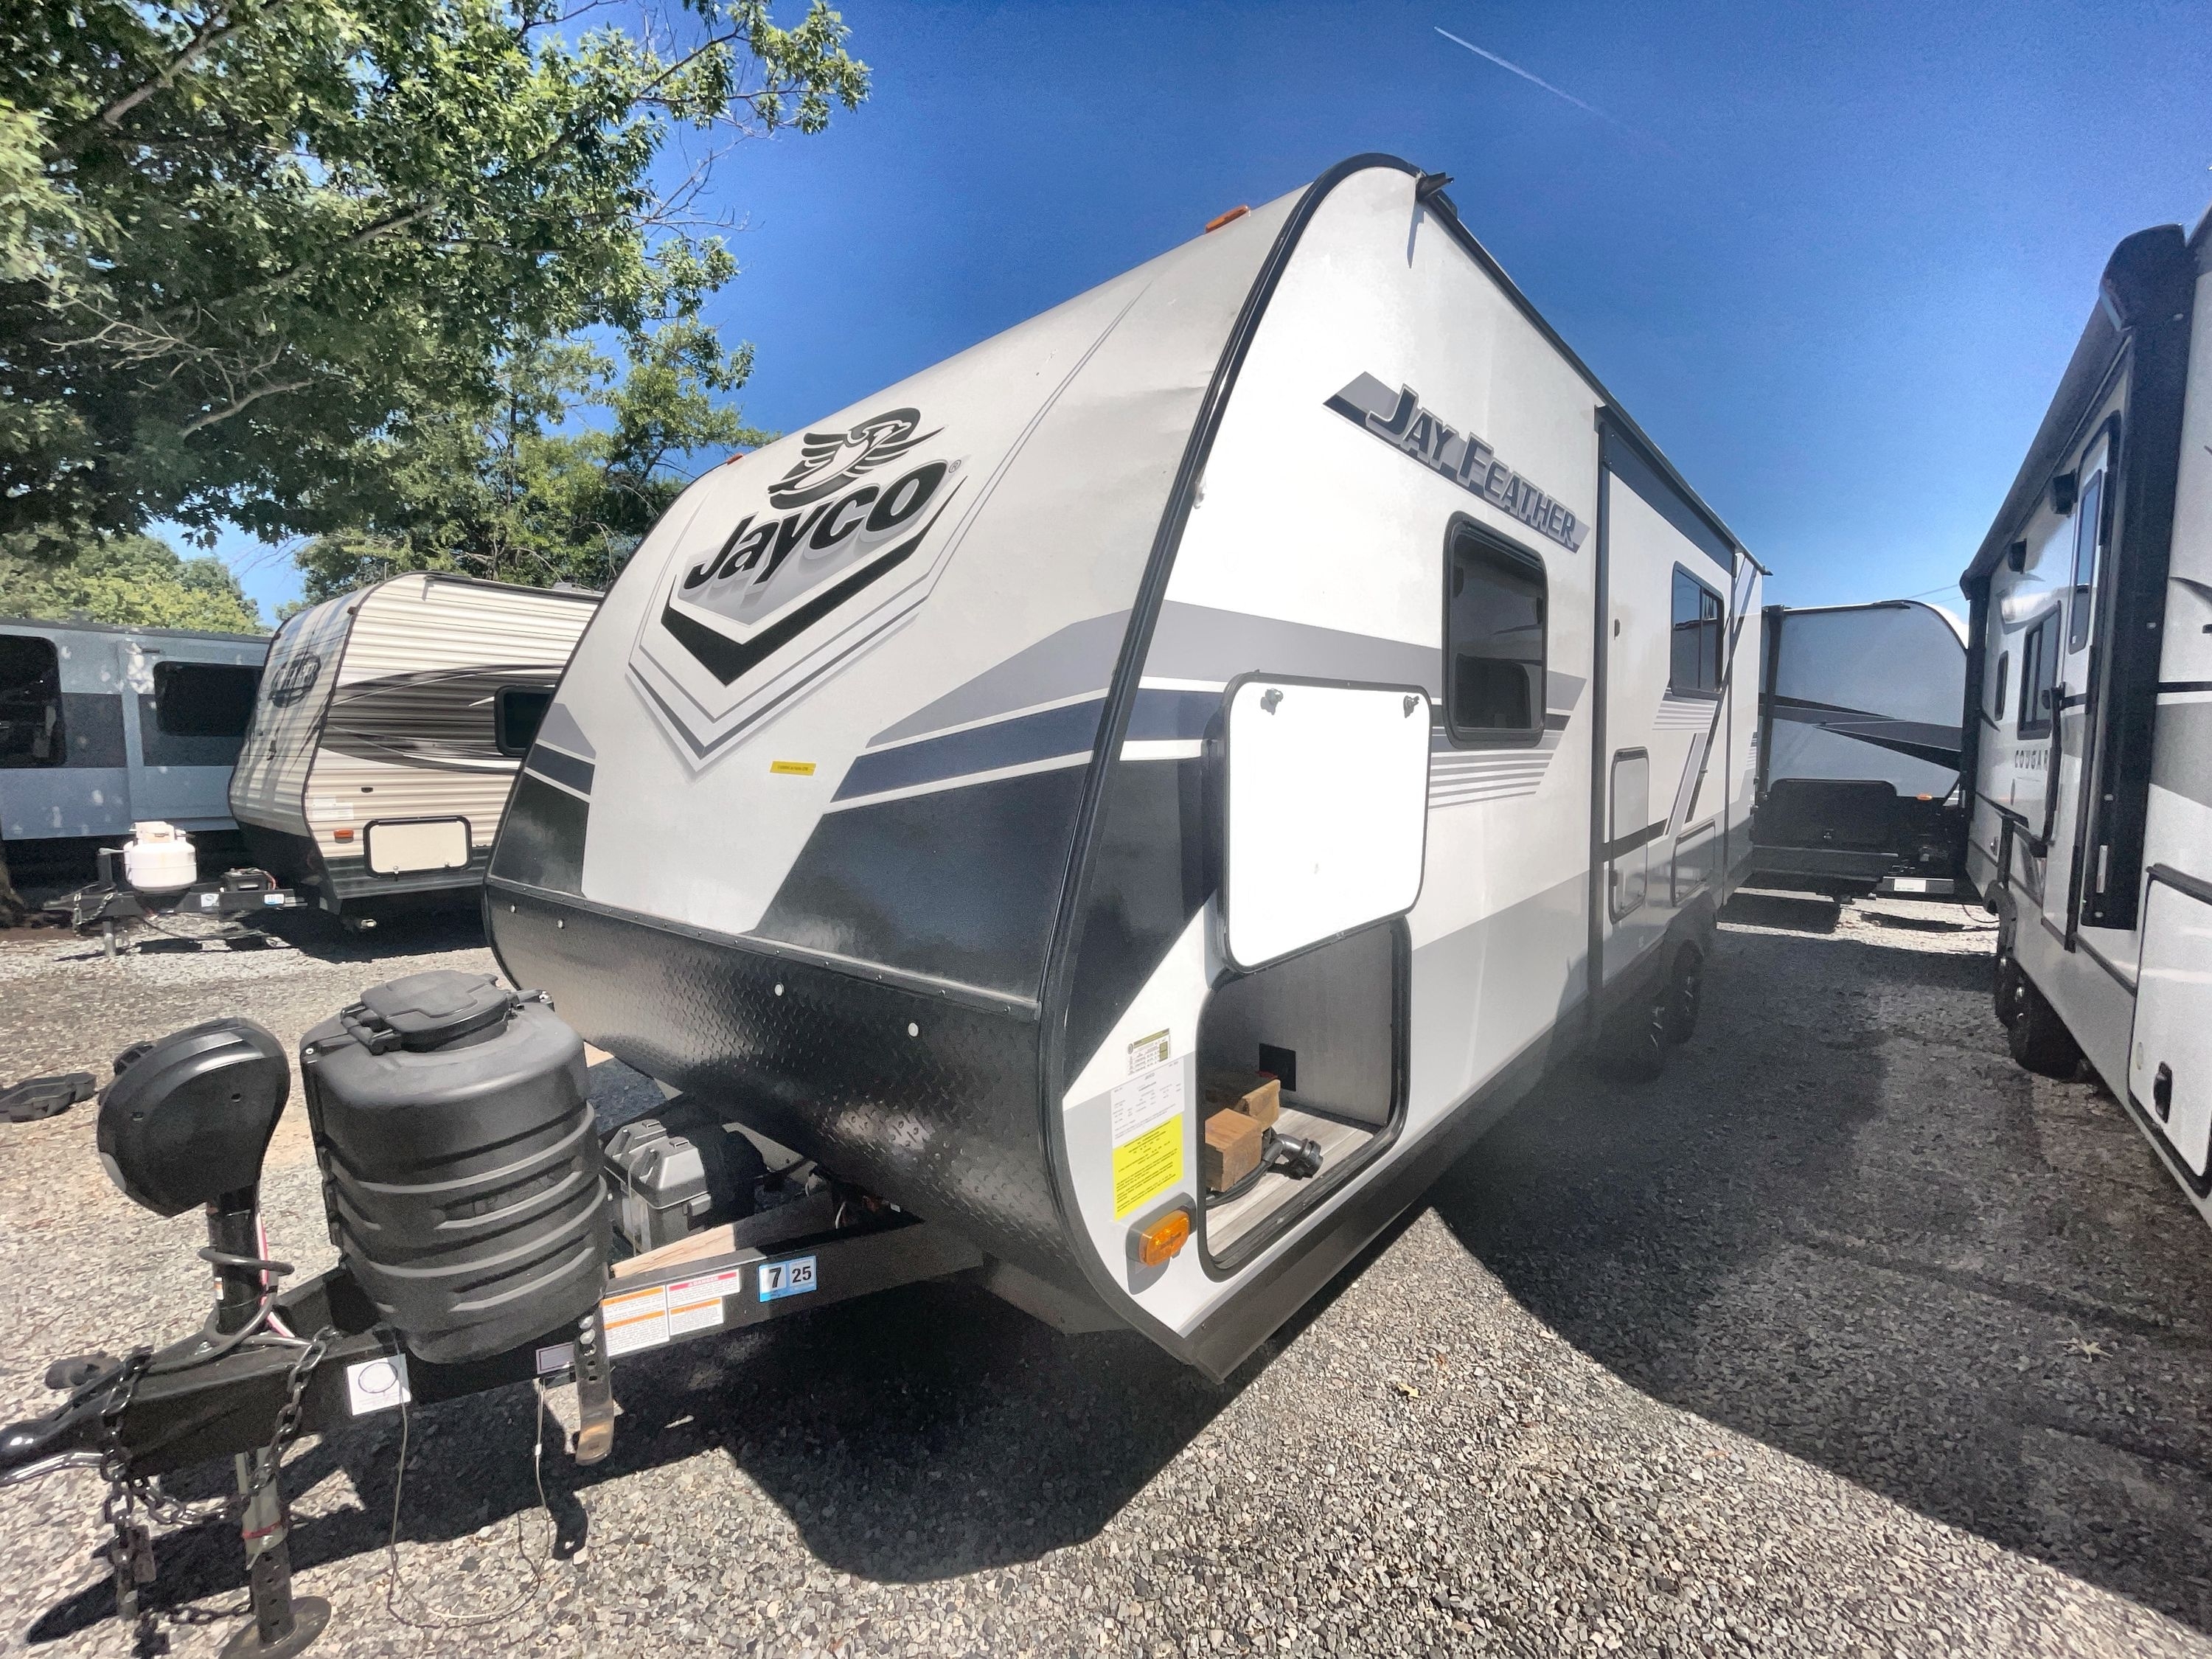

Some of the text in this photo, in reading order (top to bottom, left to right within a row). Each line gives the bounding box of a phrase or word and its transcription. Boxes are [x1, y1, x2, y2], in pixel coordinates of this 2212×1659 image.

[1367, 384, 1578, 548] JAY FEATHER
[683, 461, 948, 589] Jayco
[2014, 750, 2048, 771] COUGAR
[769, 1265, 812, 1288] 7 25
